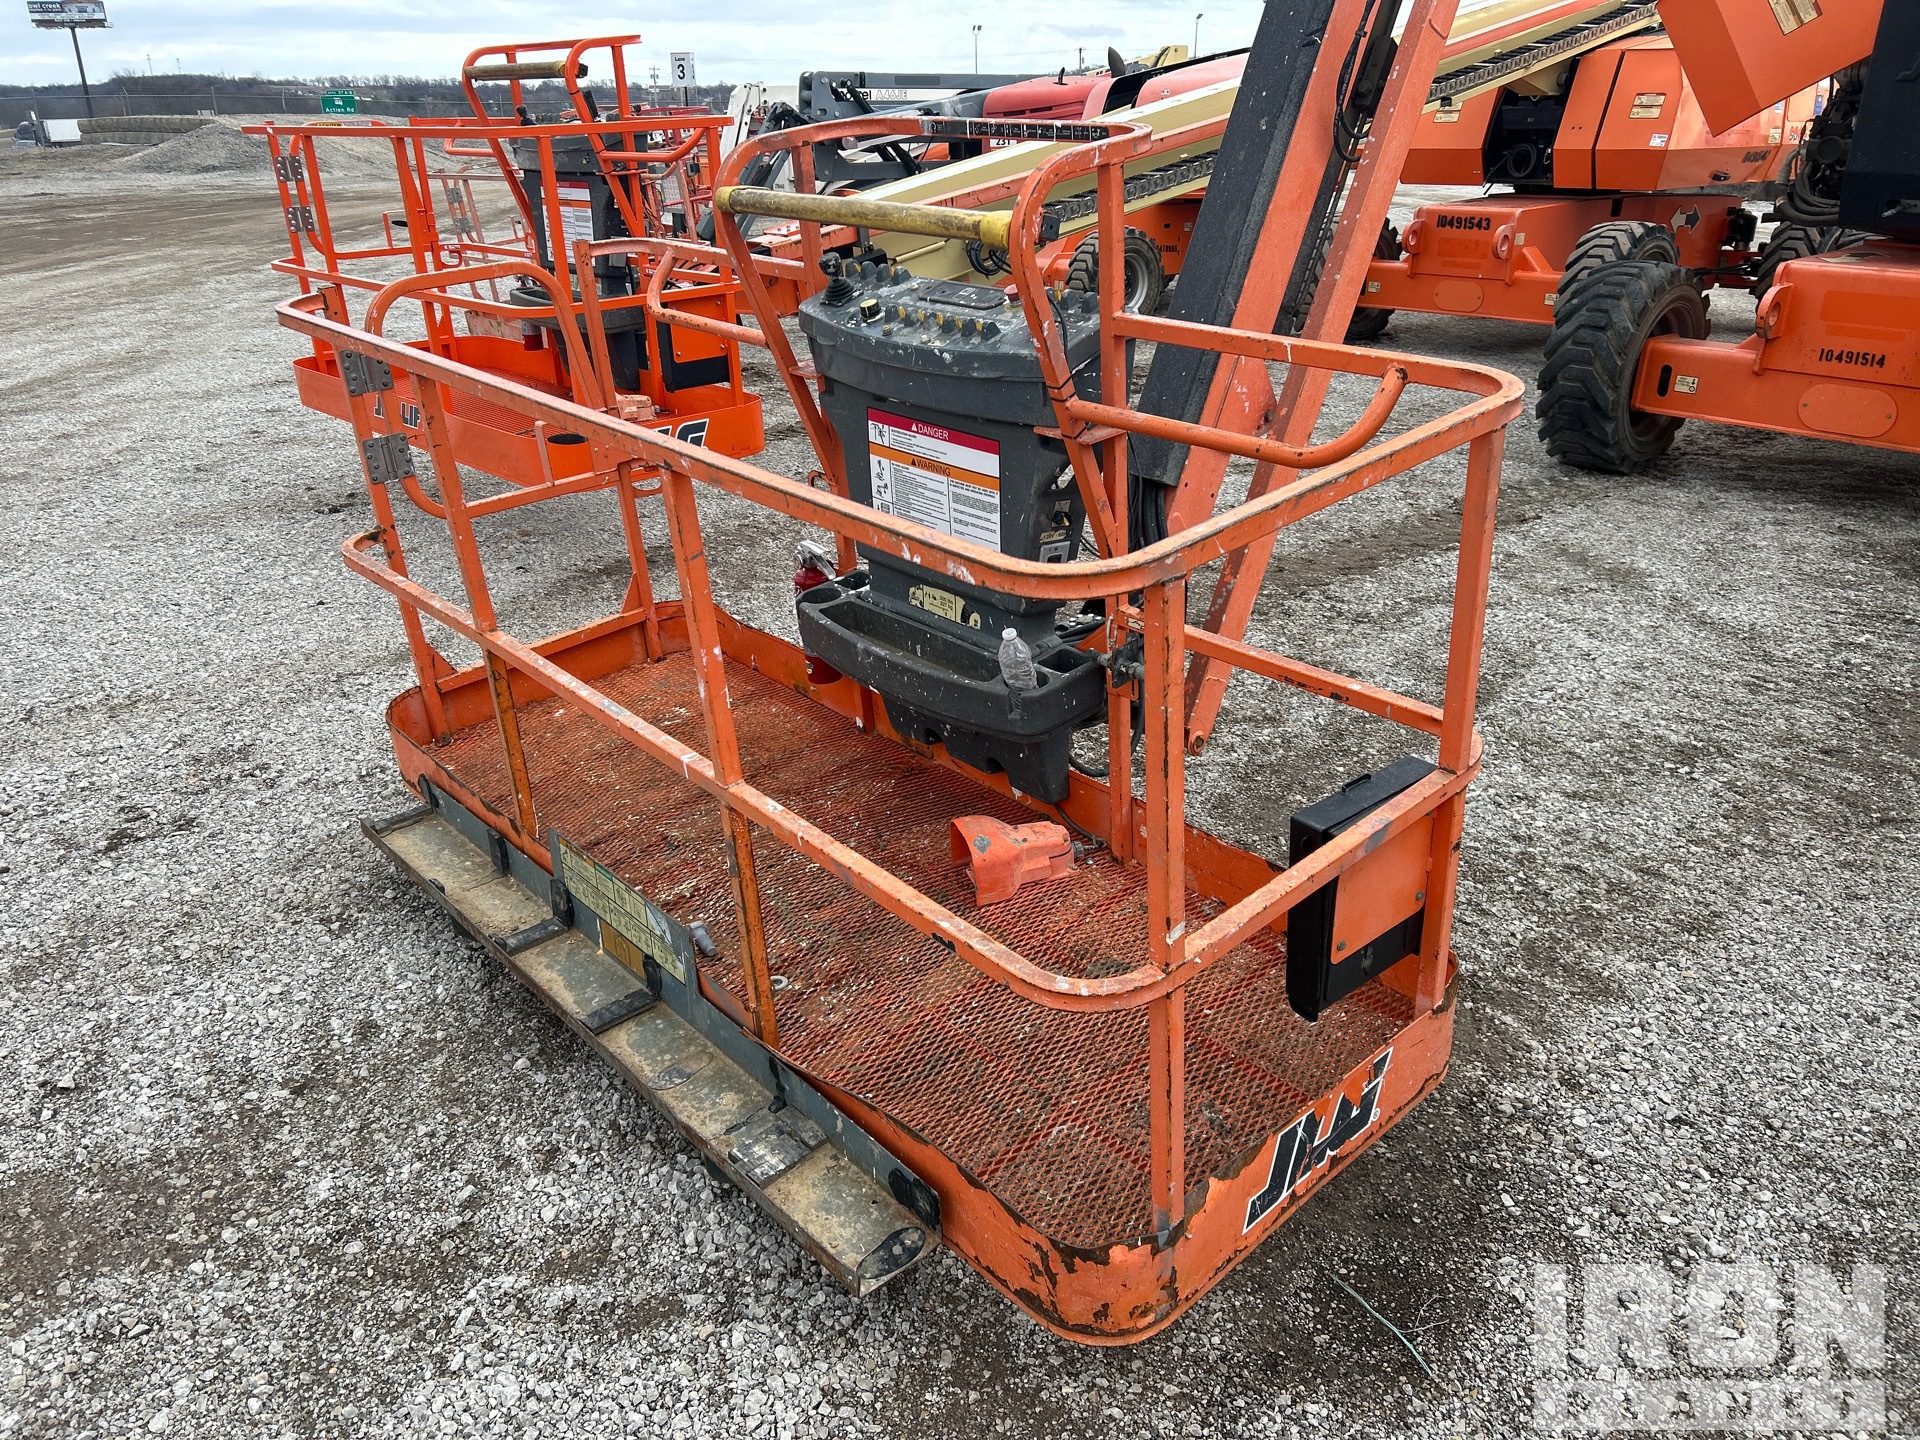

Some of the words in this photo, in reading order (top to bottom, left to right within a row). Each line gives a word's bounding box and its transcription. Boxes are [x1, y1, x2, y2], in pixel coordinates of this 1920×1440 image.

[677, 63, 686, 80] 3
[1436, 214, 1491, 231] 10491543
[1818, 347, 1886, 369] 10491514
[917, 422, 949, 441] DANGER
[915, 459, 951, 478] WARNING
